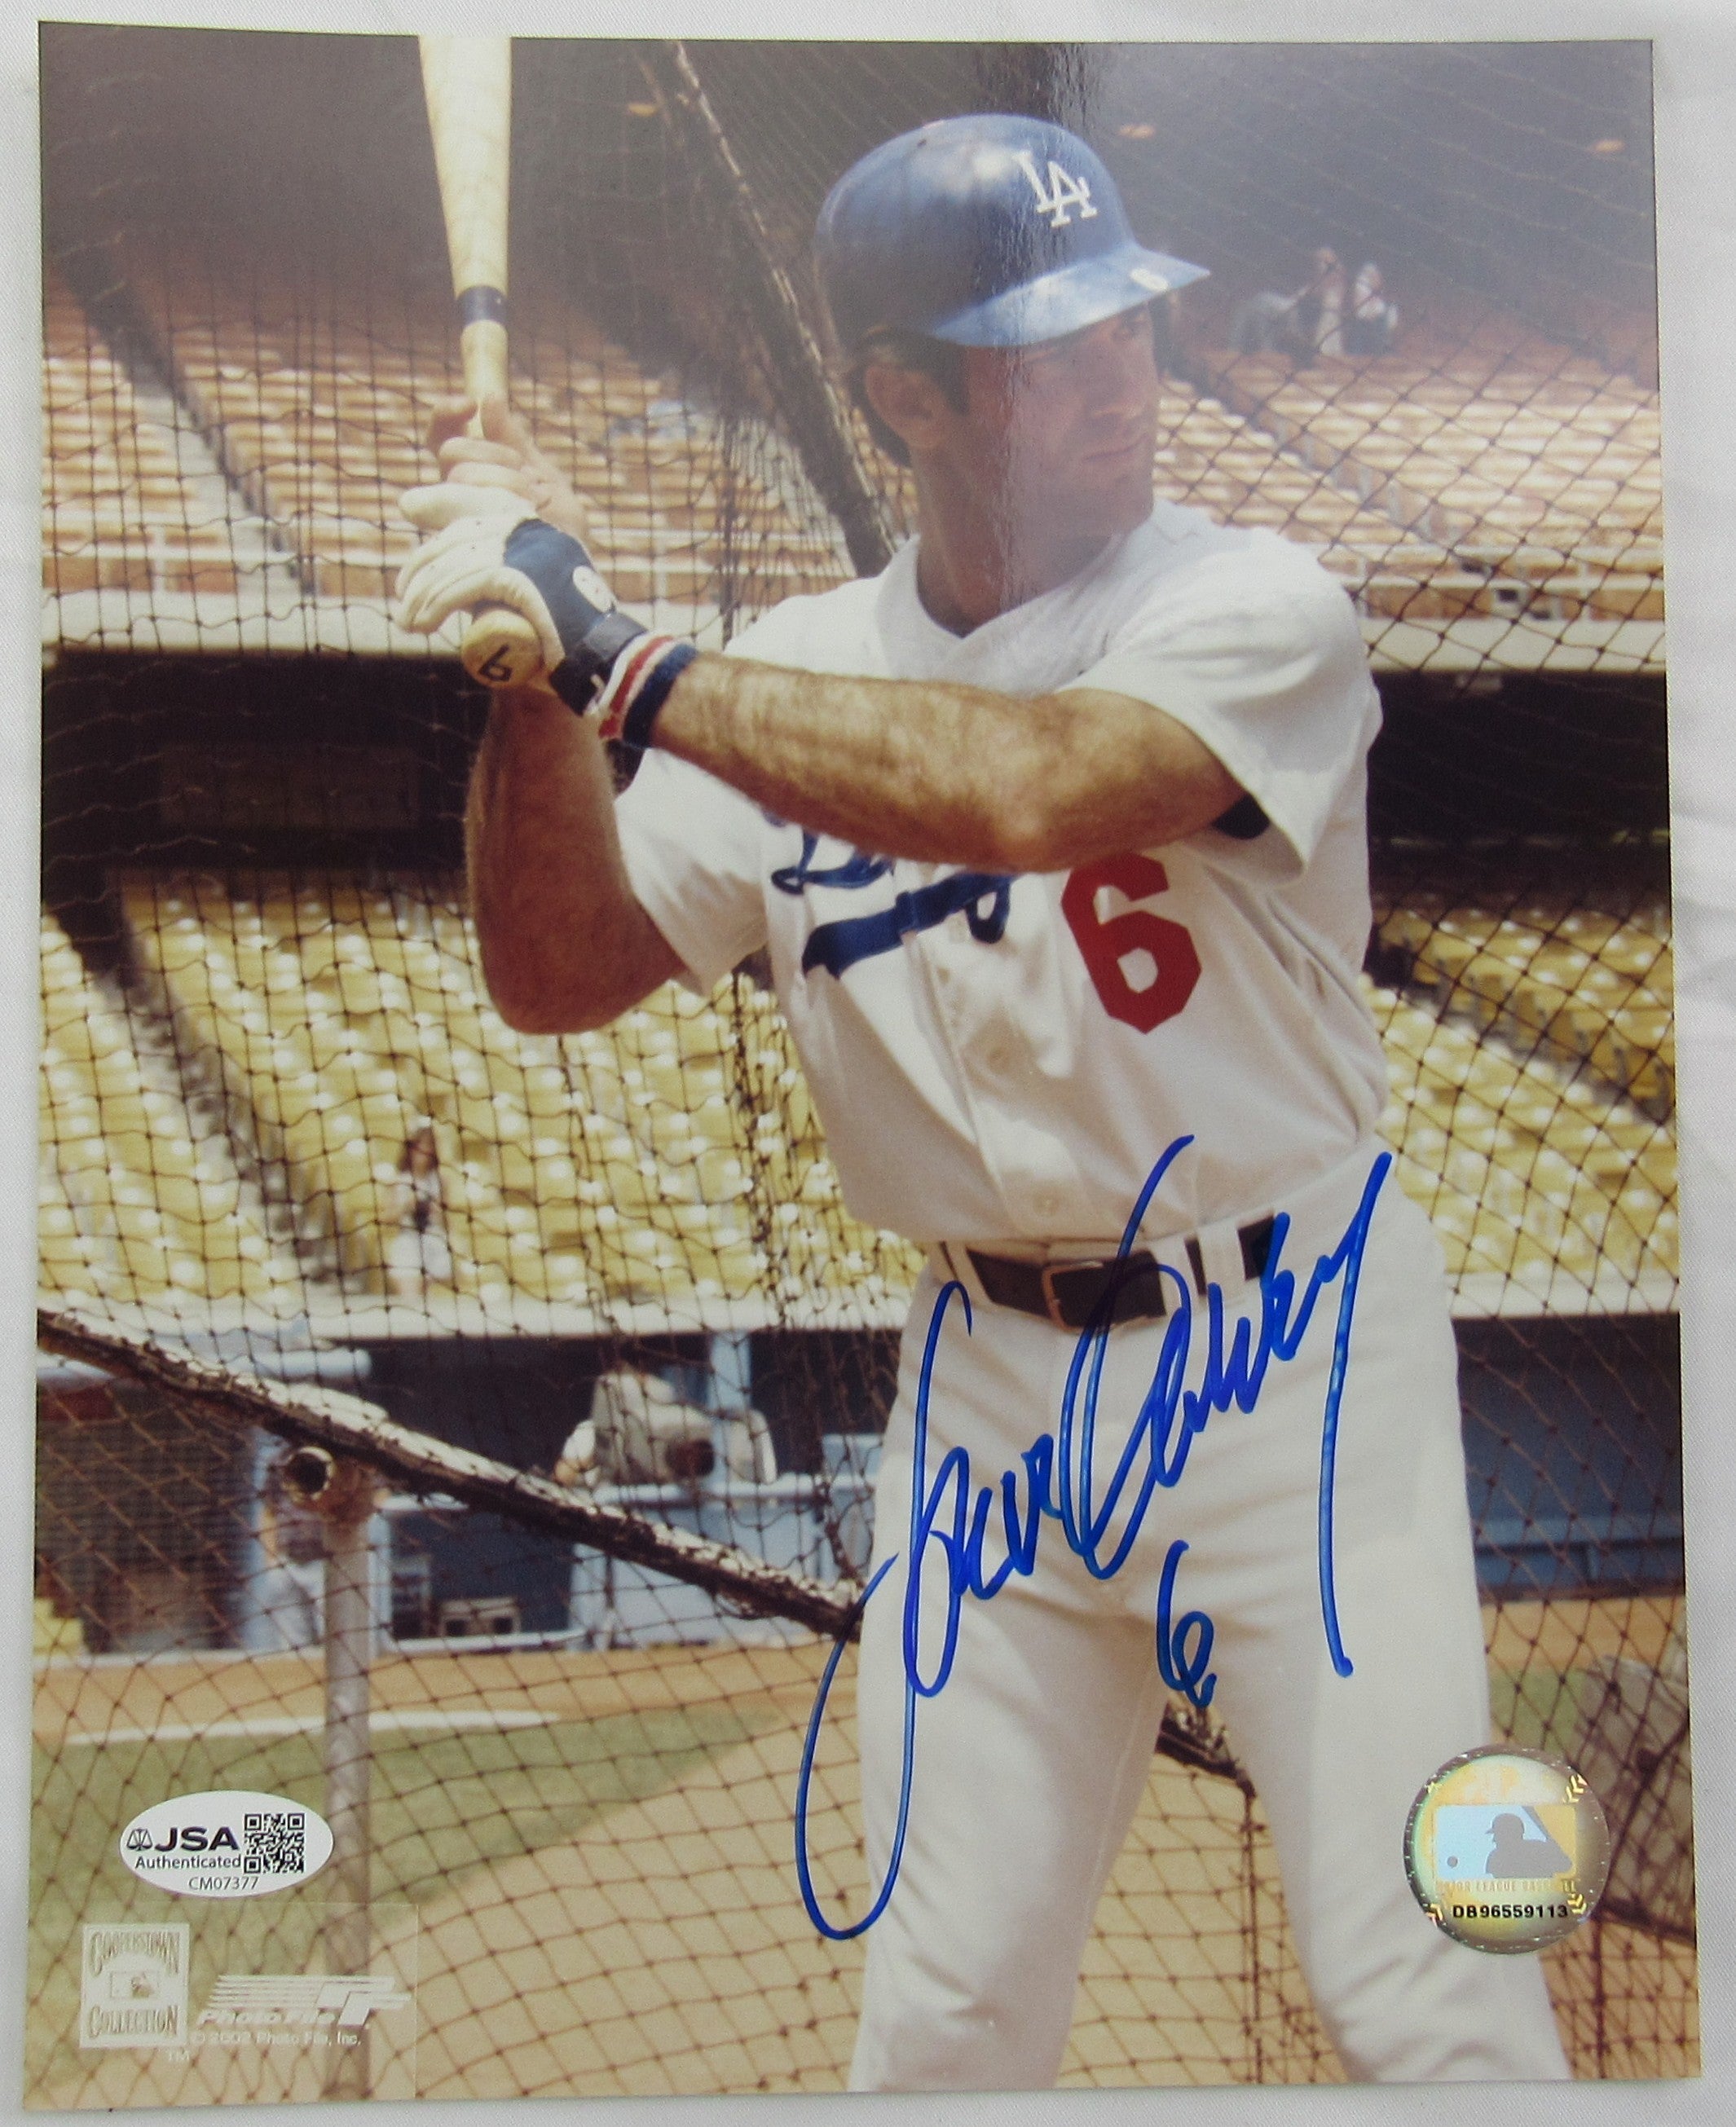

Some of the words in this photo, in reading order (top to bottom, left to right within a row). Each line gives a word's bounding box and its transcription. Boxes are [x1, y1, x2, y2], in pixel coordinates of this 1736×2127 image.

[1012, 150, 1099, 228] LA
[478, 644, 513, 683] 6
[1060, 852, 1203, 1035] 6
[1156, 1539, 1218, 1708] 6
[155, 1826, 240, 1852] JSA
[135, 1855, 242, 1870] Authenticated
[188, 1876, 259, 1891] CM07377
[1452, 1905, 1569, 1918] DB96559113
[337, 2030, 362, 2046] Inc.
